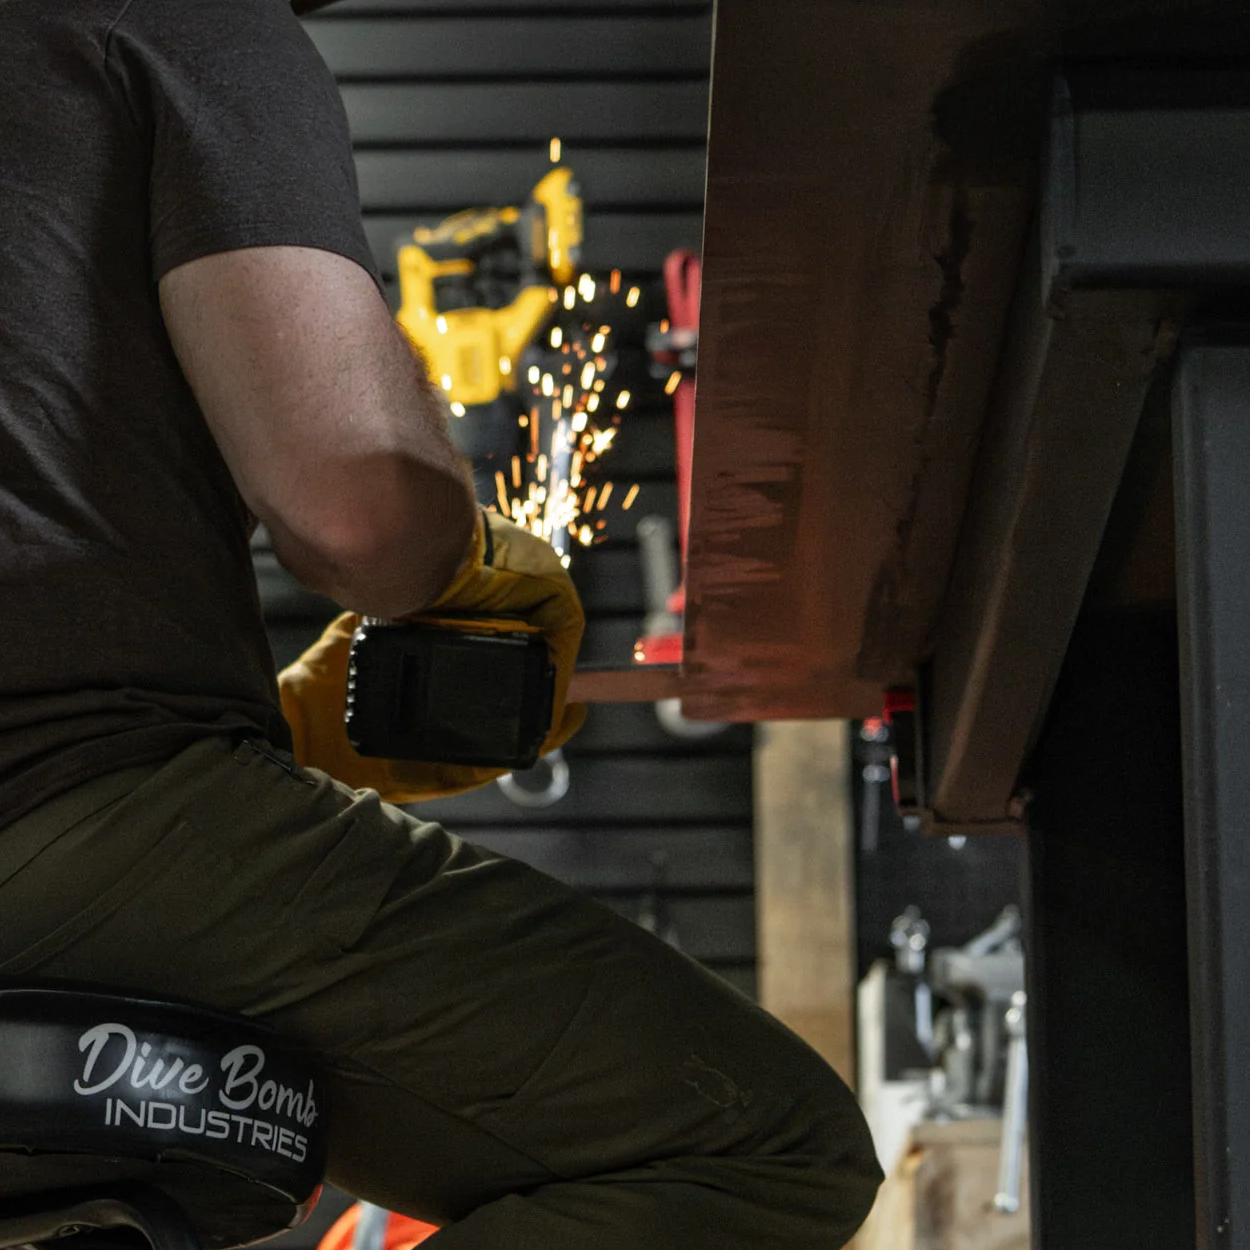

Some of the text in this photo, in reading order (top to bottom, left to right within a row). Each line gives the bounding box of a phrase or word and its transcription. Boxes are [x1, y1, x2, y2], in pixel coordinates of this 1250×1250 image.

[73, 1022, 319, 1128] Dive Bomb
[104, 1098, 308, 1163] INDUSTRIES
